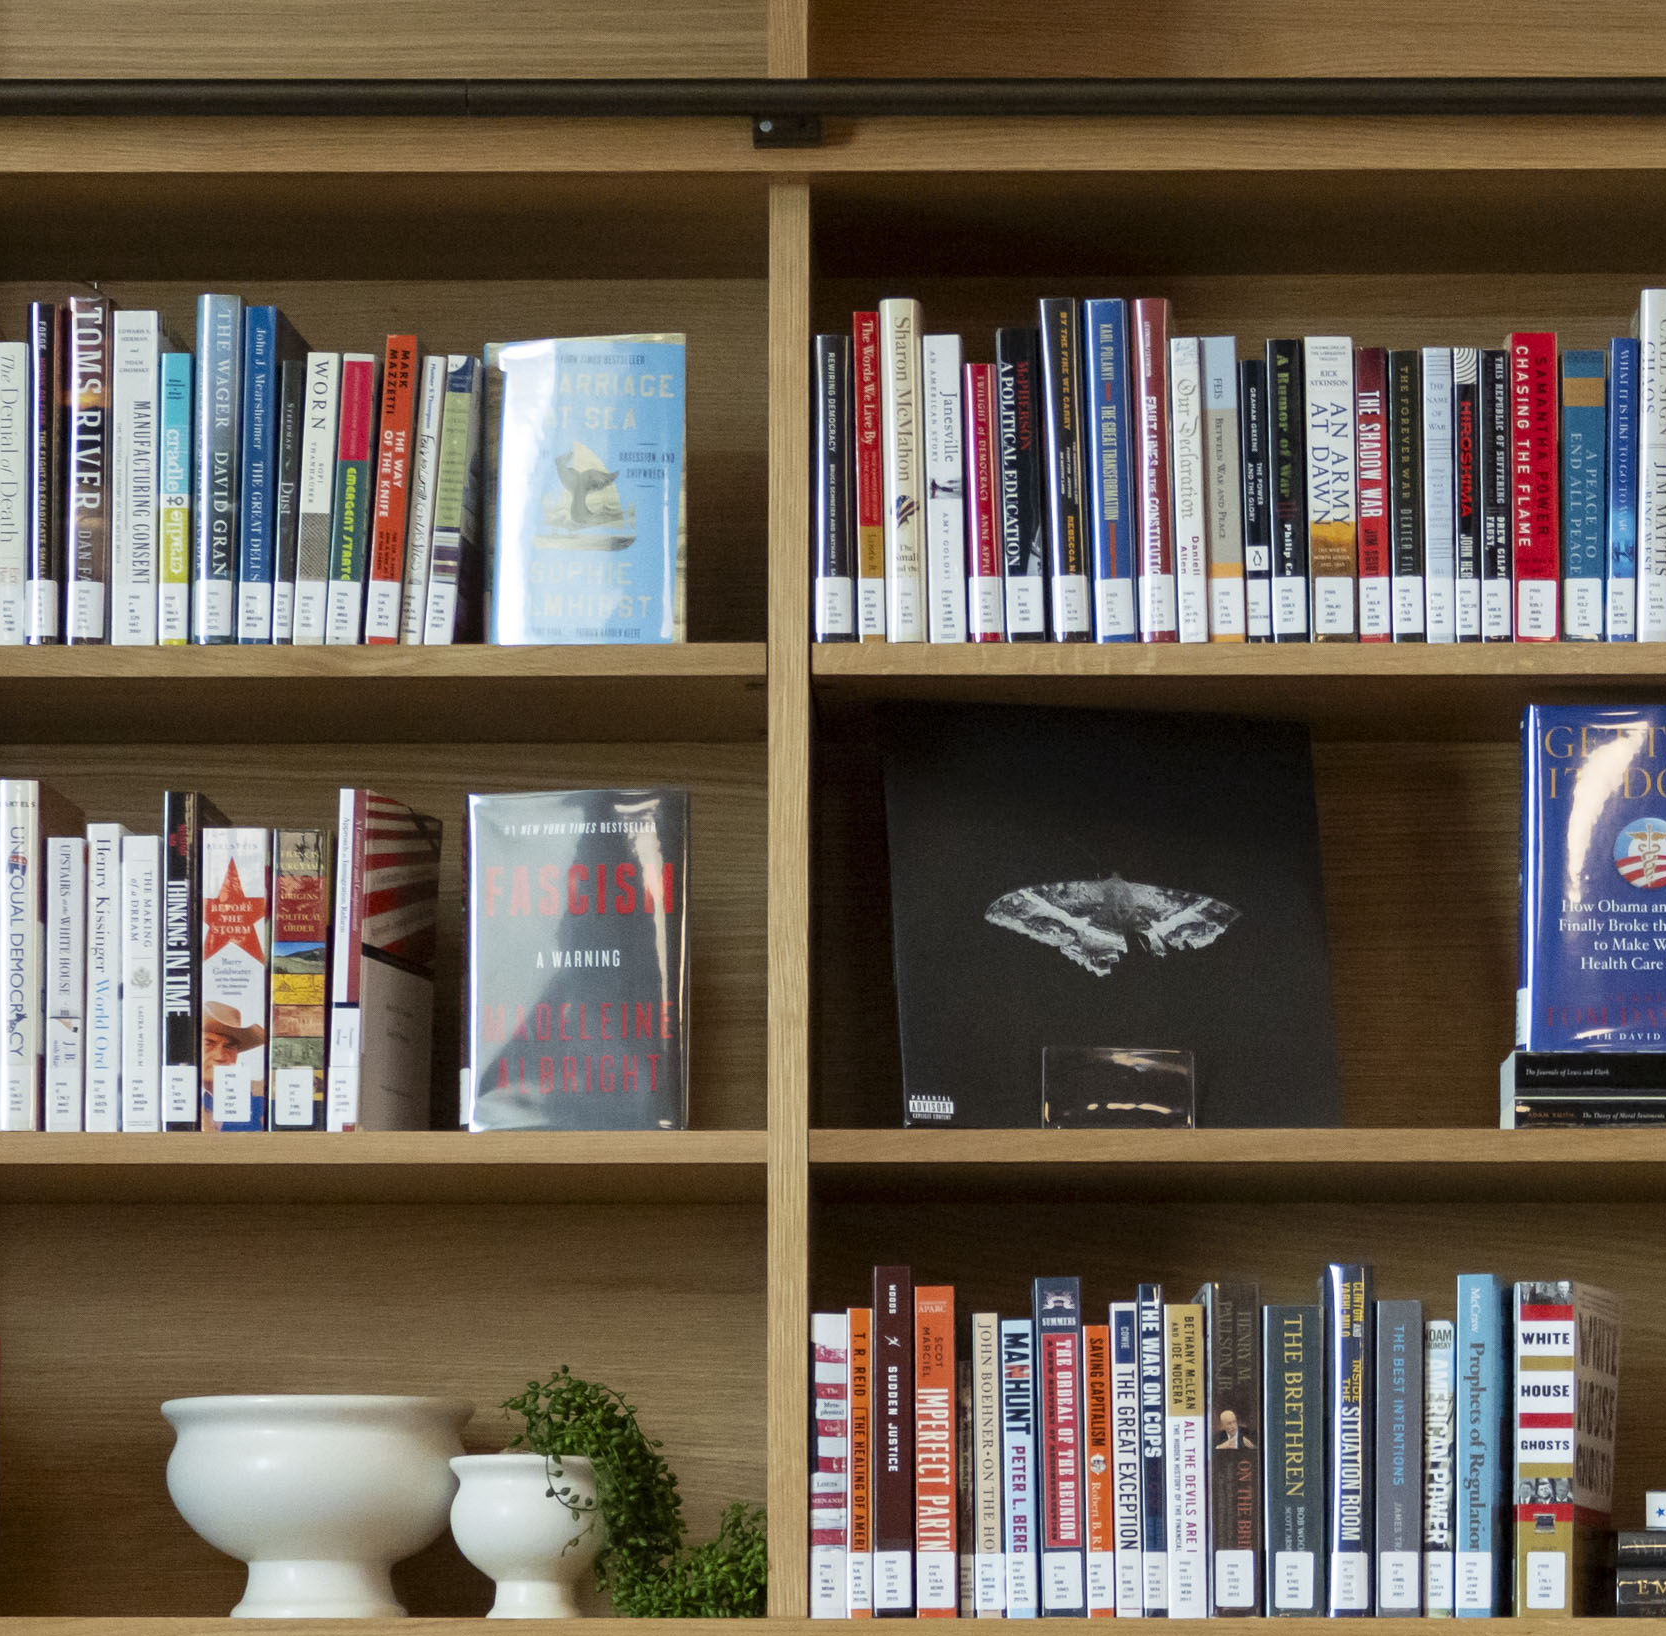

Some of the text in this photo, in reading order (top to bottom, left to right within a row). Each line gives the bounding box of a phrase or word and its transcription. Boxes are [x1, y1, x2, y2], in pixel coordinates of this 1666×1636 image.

[75, 306, 102, 509] TOMS RIVER
[311, 360, 329, 431] WORN
[1459, 401, 1473, 517] HIROSHIMA
[1516, 346, 1530, 547] CHASING THE FLAME
[132, 400, 150, 585] MANUFACTURING CONSENT
[165, 880, 190, 1017] THINKING IN TIME
[537, 950, 620, 968] A WARNING
[1581, 957, 1627, 970] Health
[1631, 958, 1663, 970] Care
[910, 1101, 953, 1113] ADVISORY
[1522, 1333, 1570, 1345] WHITE
[1004, 1333, 1030, 1435] MANHUNT
[1283, 1315, 1304, 1497] THE BRETHREN
[1521, 1385, 1569, 1397] HOUSE
[1521, 1439, 1569, 1450] GHOSTS
